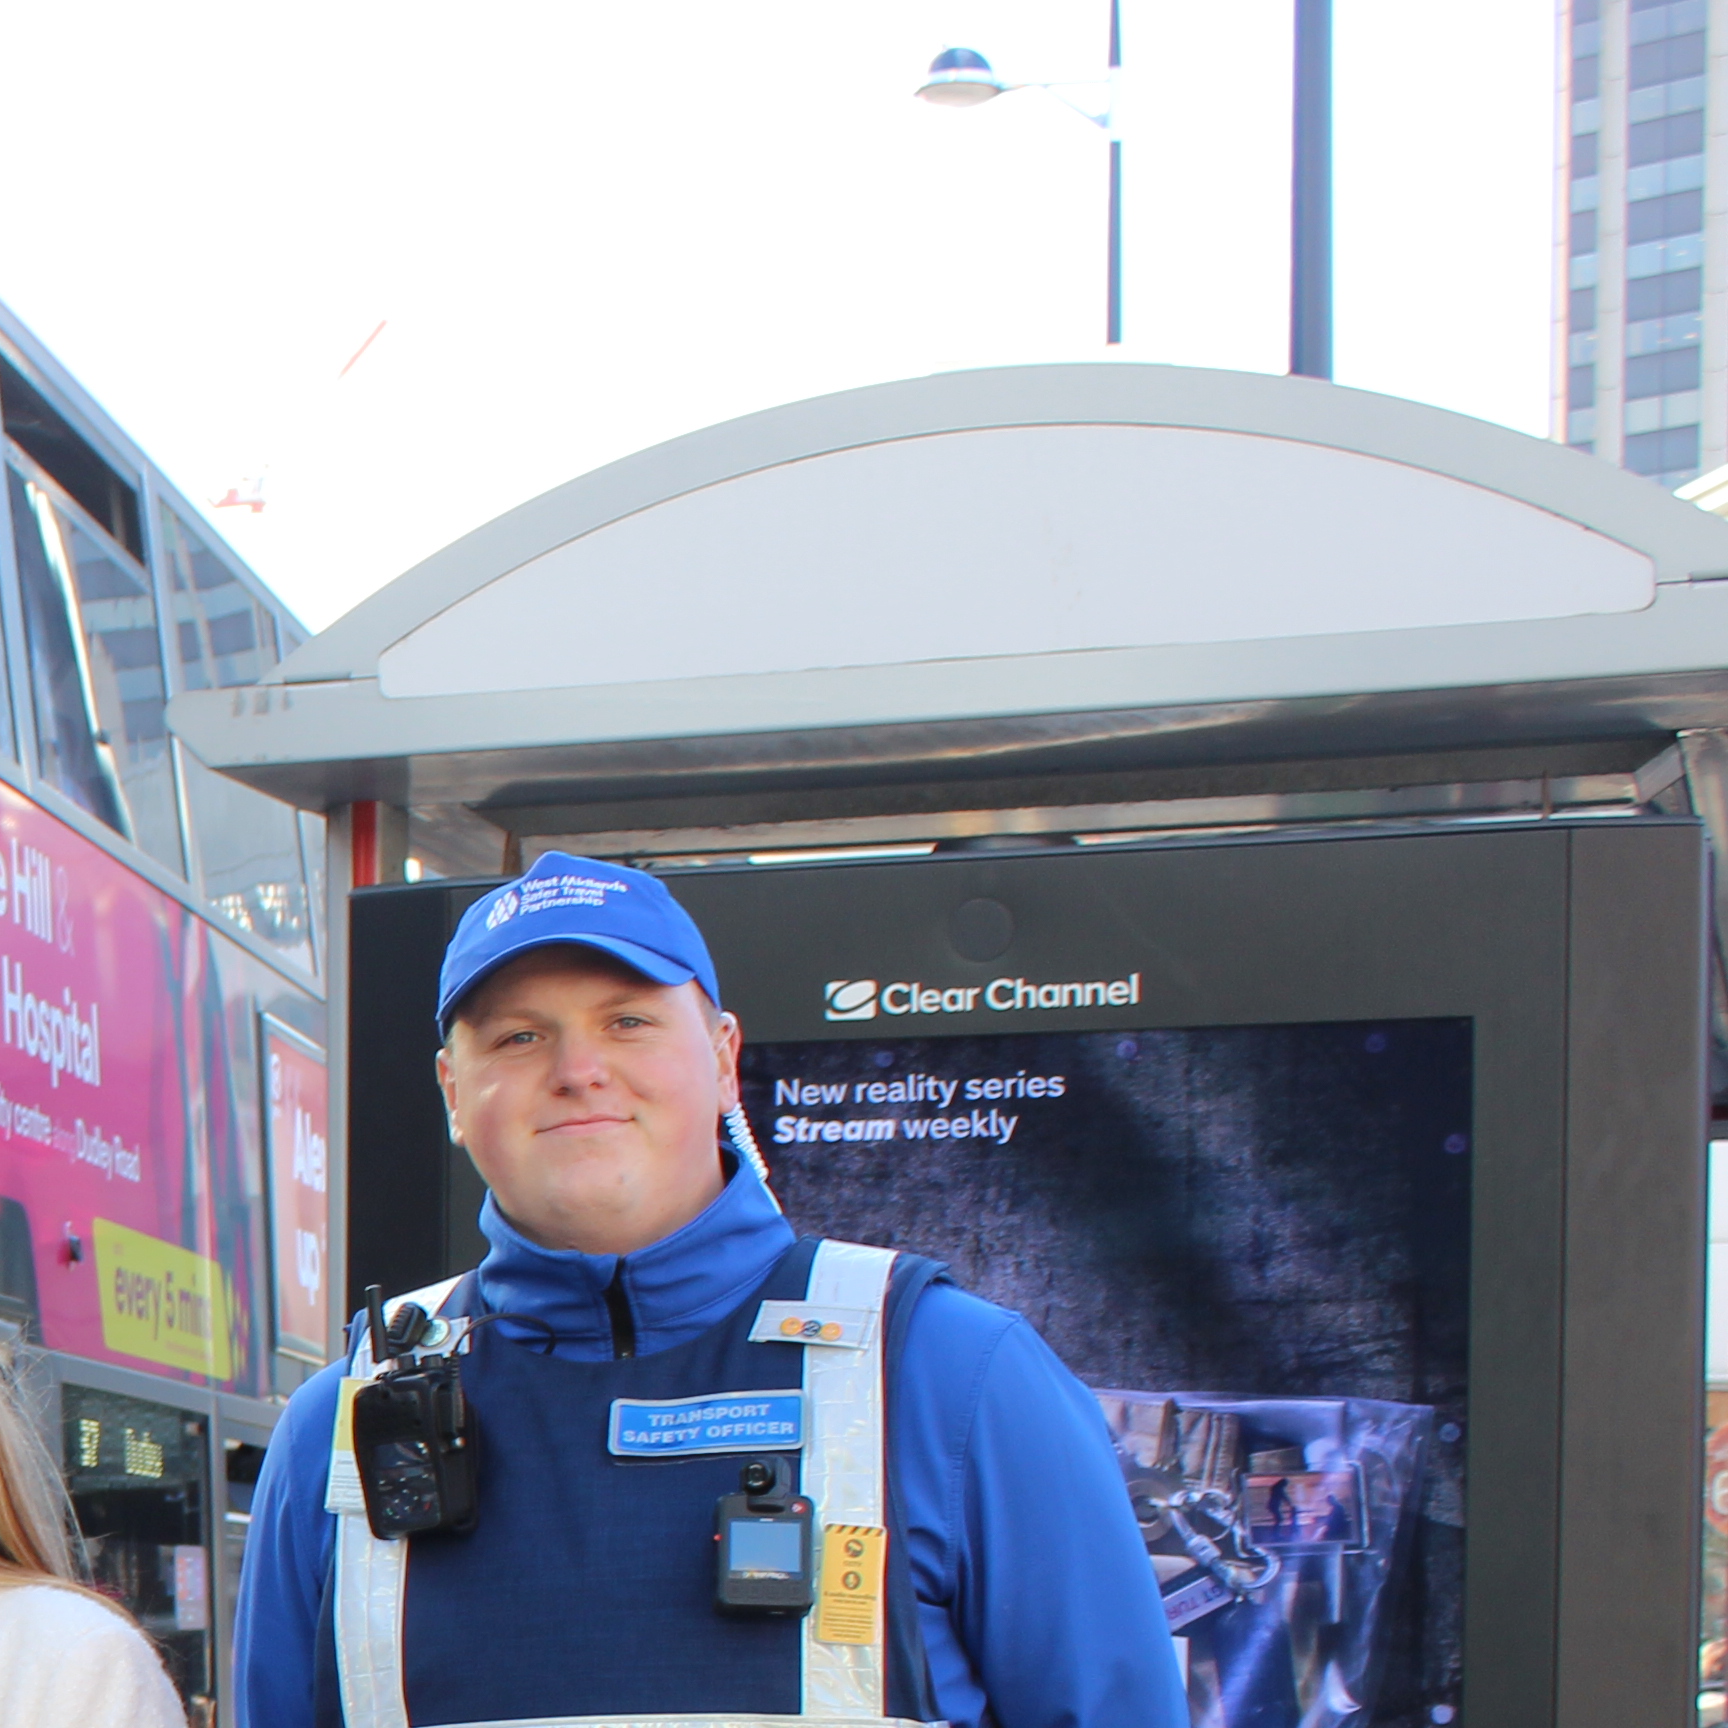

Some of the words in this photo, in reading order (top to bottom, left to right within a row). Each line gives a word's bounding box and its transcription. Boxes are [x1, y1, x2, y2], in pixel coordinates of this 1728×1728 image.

[11, 837, 53, 944] Hill
[57, 866, 75, 956] &
[880, 982, 981, 1015] Clear
[985, 972, 1142, 1011] Channel
[2, 955, 101, 1088] Hospital
[774, 1078, 848, 1106] New
[854, 1073, 959, 1109] reality
[964, 1070, 1067, 1100] series
[774, 1114, 896, 1144] Stream
[902, 1108, 1020, 1145] weekly
[75, 1118, 113, 1181] Dudley
[114, 1134, 141, 1183] Road
[115, 1266, 162, 1341] every
[165, 1270, 175, 1330] 5
[622, 1426, 702, 1444] SAFETY
[706, 1421, 795, 1438] OFFICER
[647, 1403, 771, 1427] TRANSPORT
